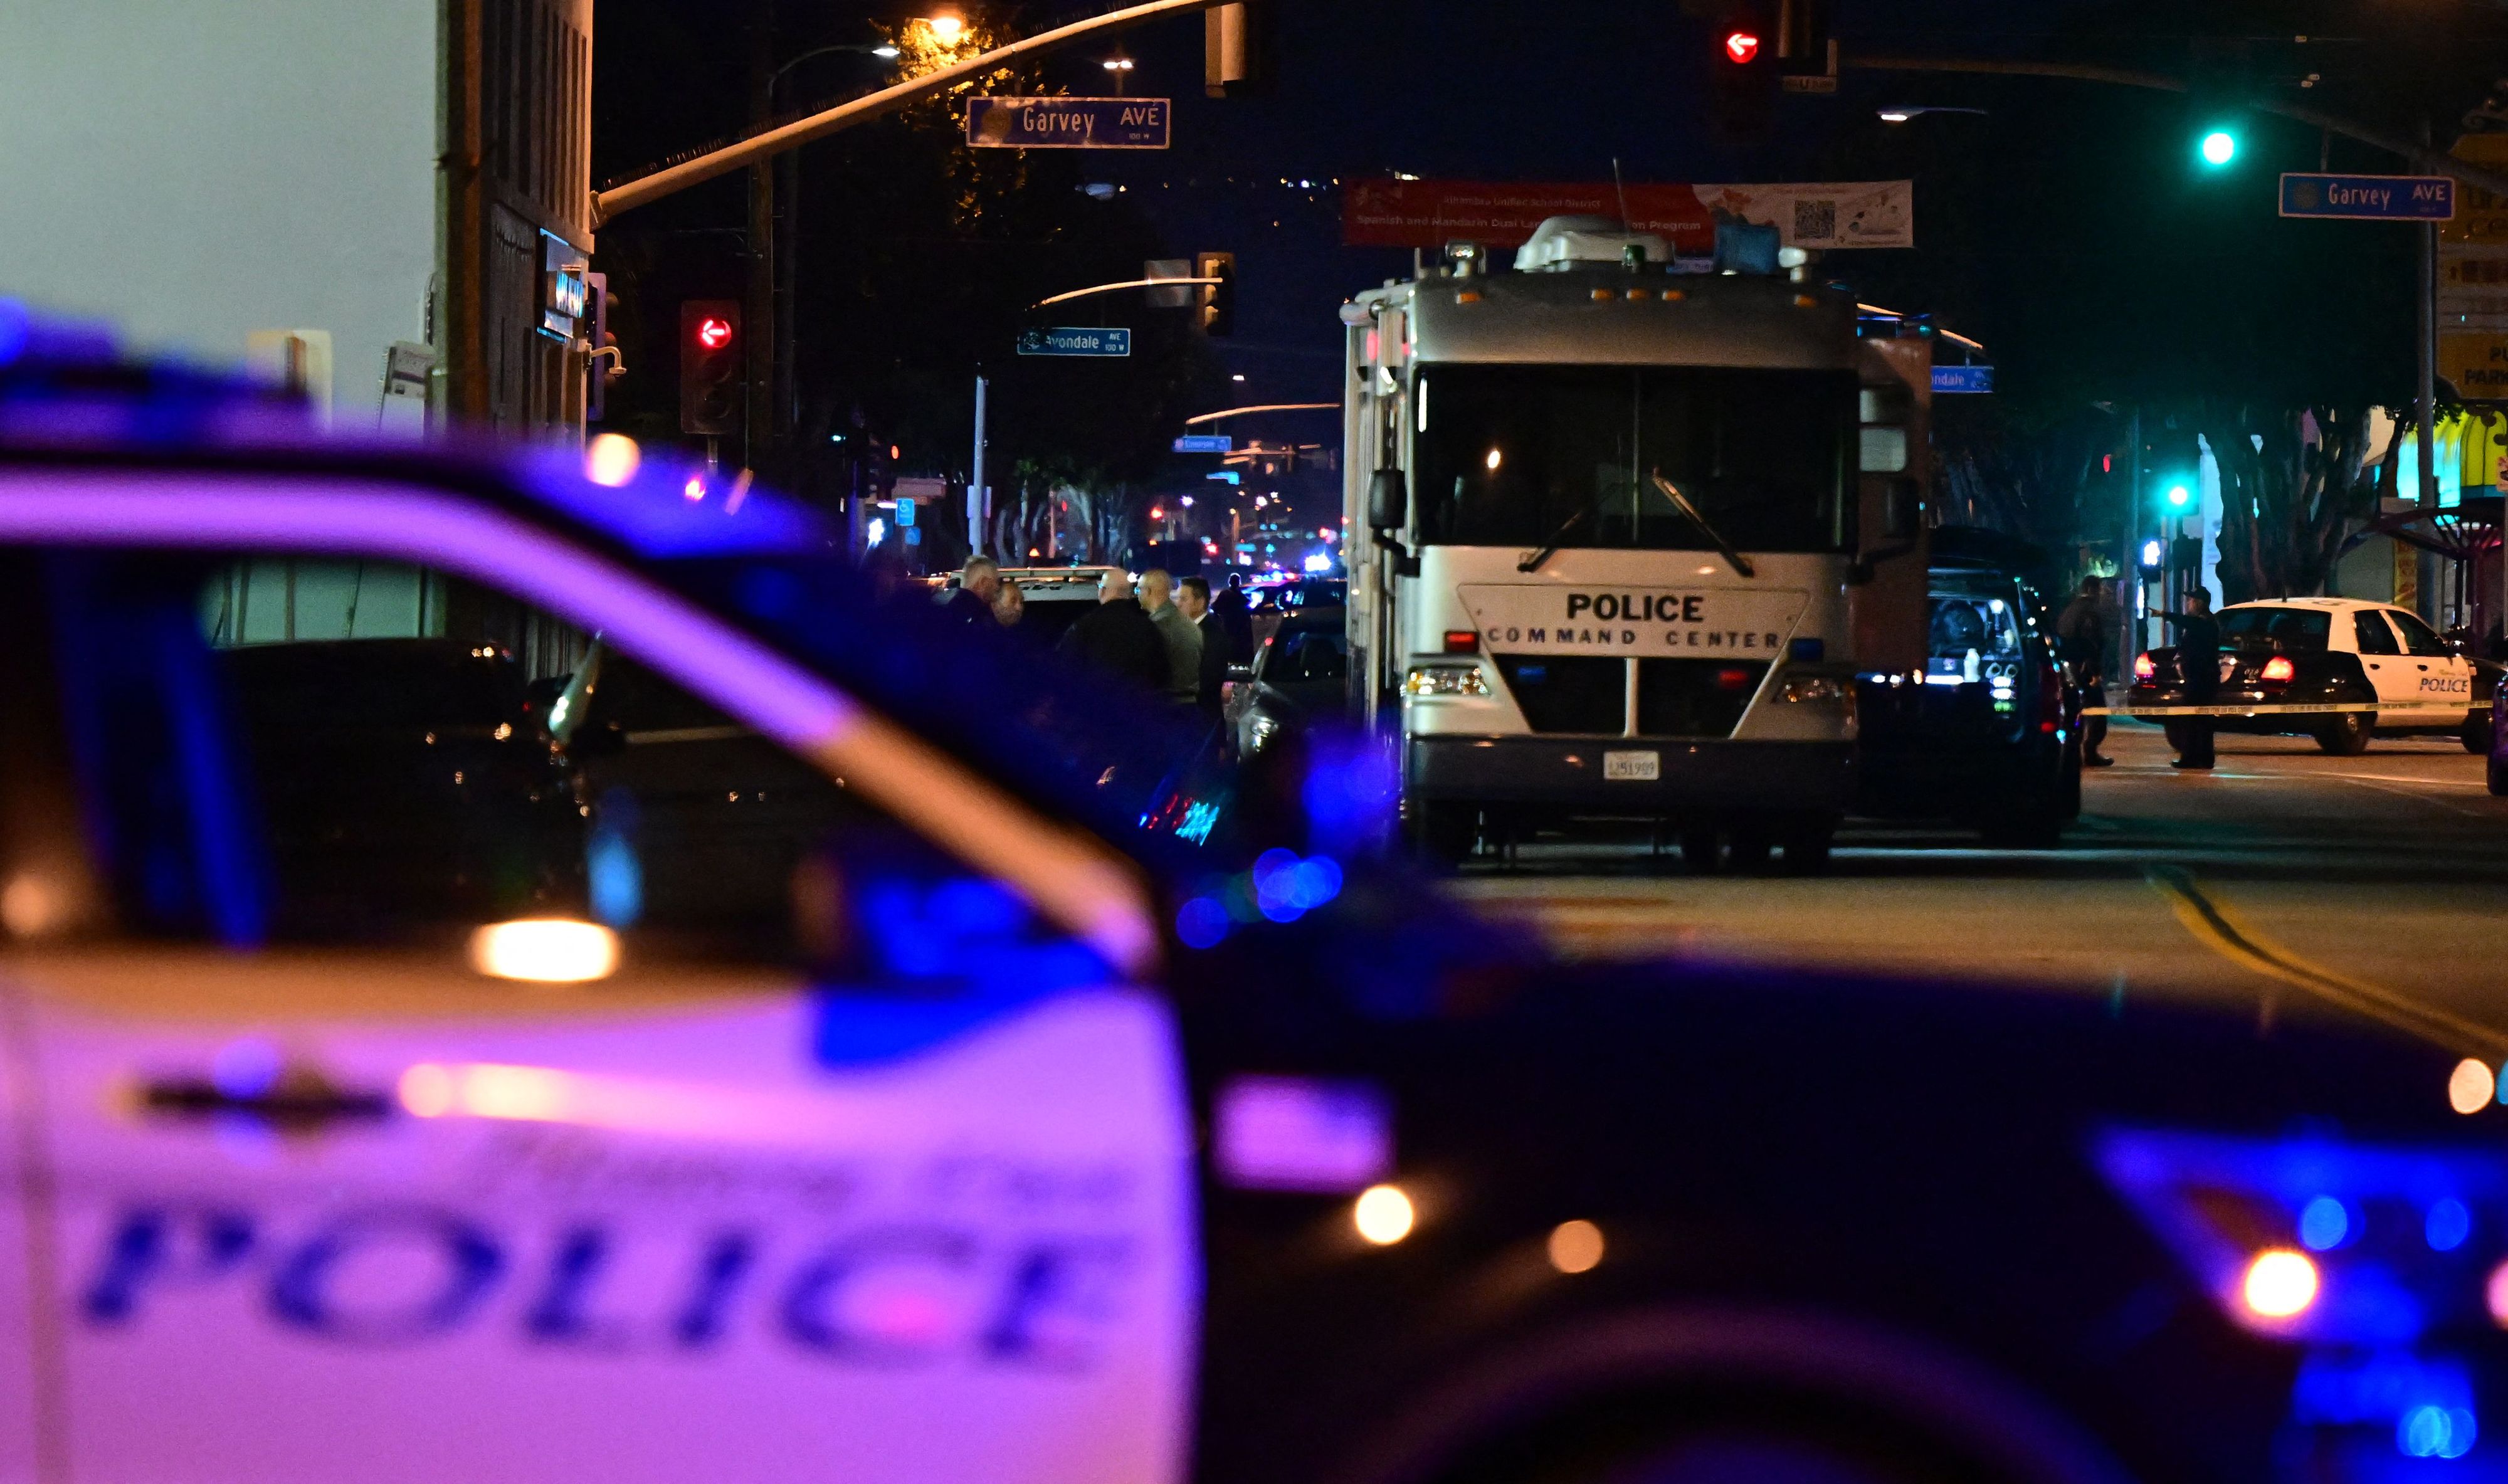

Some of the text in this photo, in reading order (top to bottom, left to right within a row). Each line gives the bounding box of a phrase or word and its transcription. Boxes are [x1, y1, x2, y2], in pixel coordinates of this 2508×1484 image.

[1023, 107, 1159, 138] Garvey AVE
[2328, 184, 2391, 211] Garvey
[2411, 184, 2446, 201] AVE
[1356, 215, 1403, 227] Spanish
[1406, 216, 1429, 226] and
[1431, 217, 1488, 228] Mandarin
[1650, 221, 1701, 231] Program
[1109, 332, 1122, 341] AVE
[1105, 344, 1125, 352] 100 W
[1931, 372, 1965, 386] ndale
[1568, 593, 1704, 622] POLICE
[1488, 628, 1780, 649] COMMAND CENTER
[2419, 678, 2468, 693] POLICE
[76, 1196, 1136, 1373] POLICE
